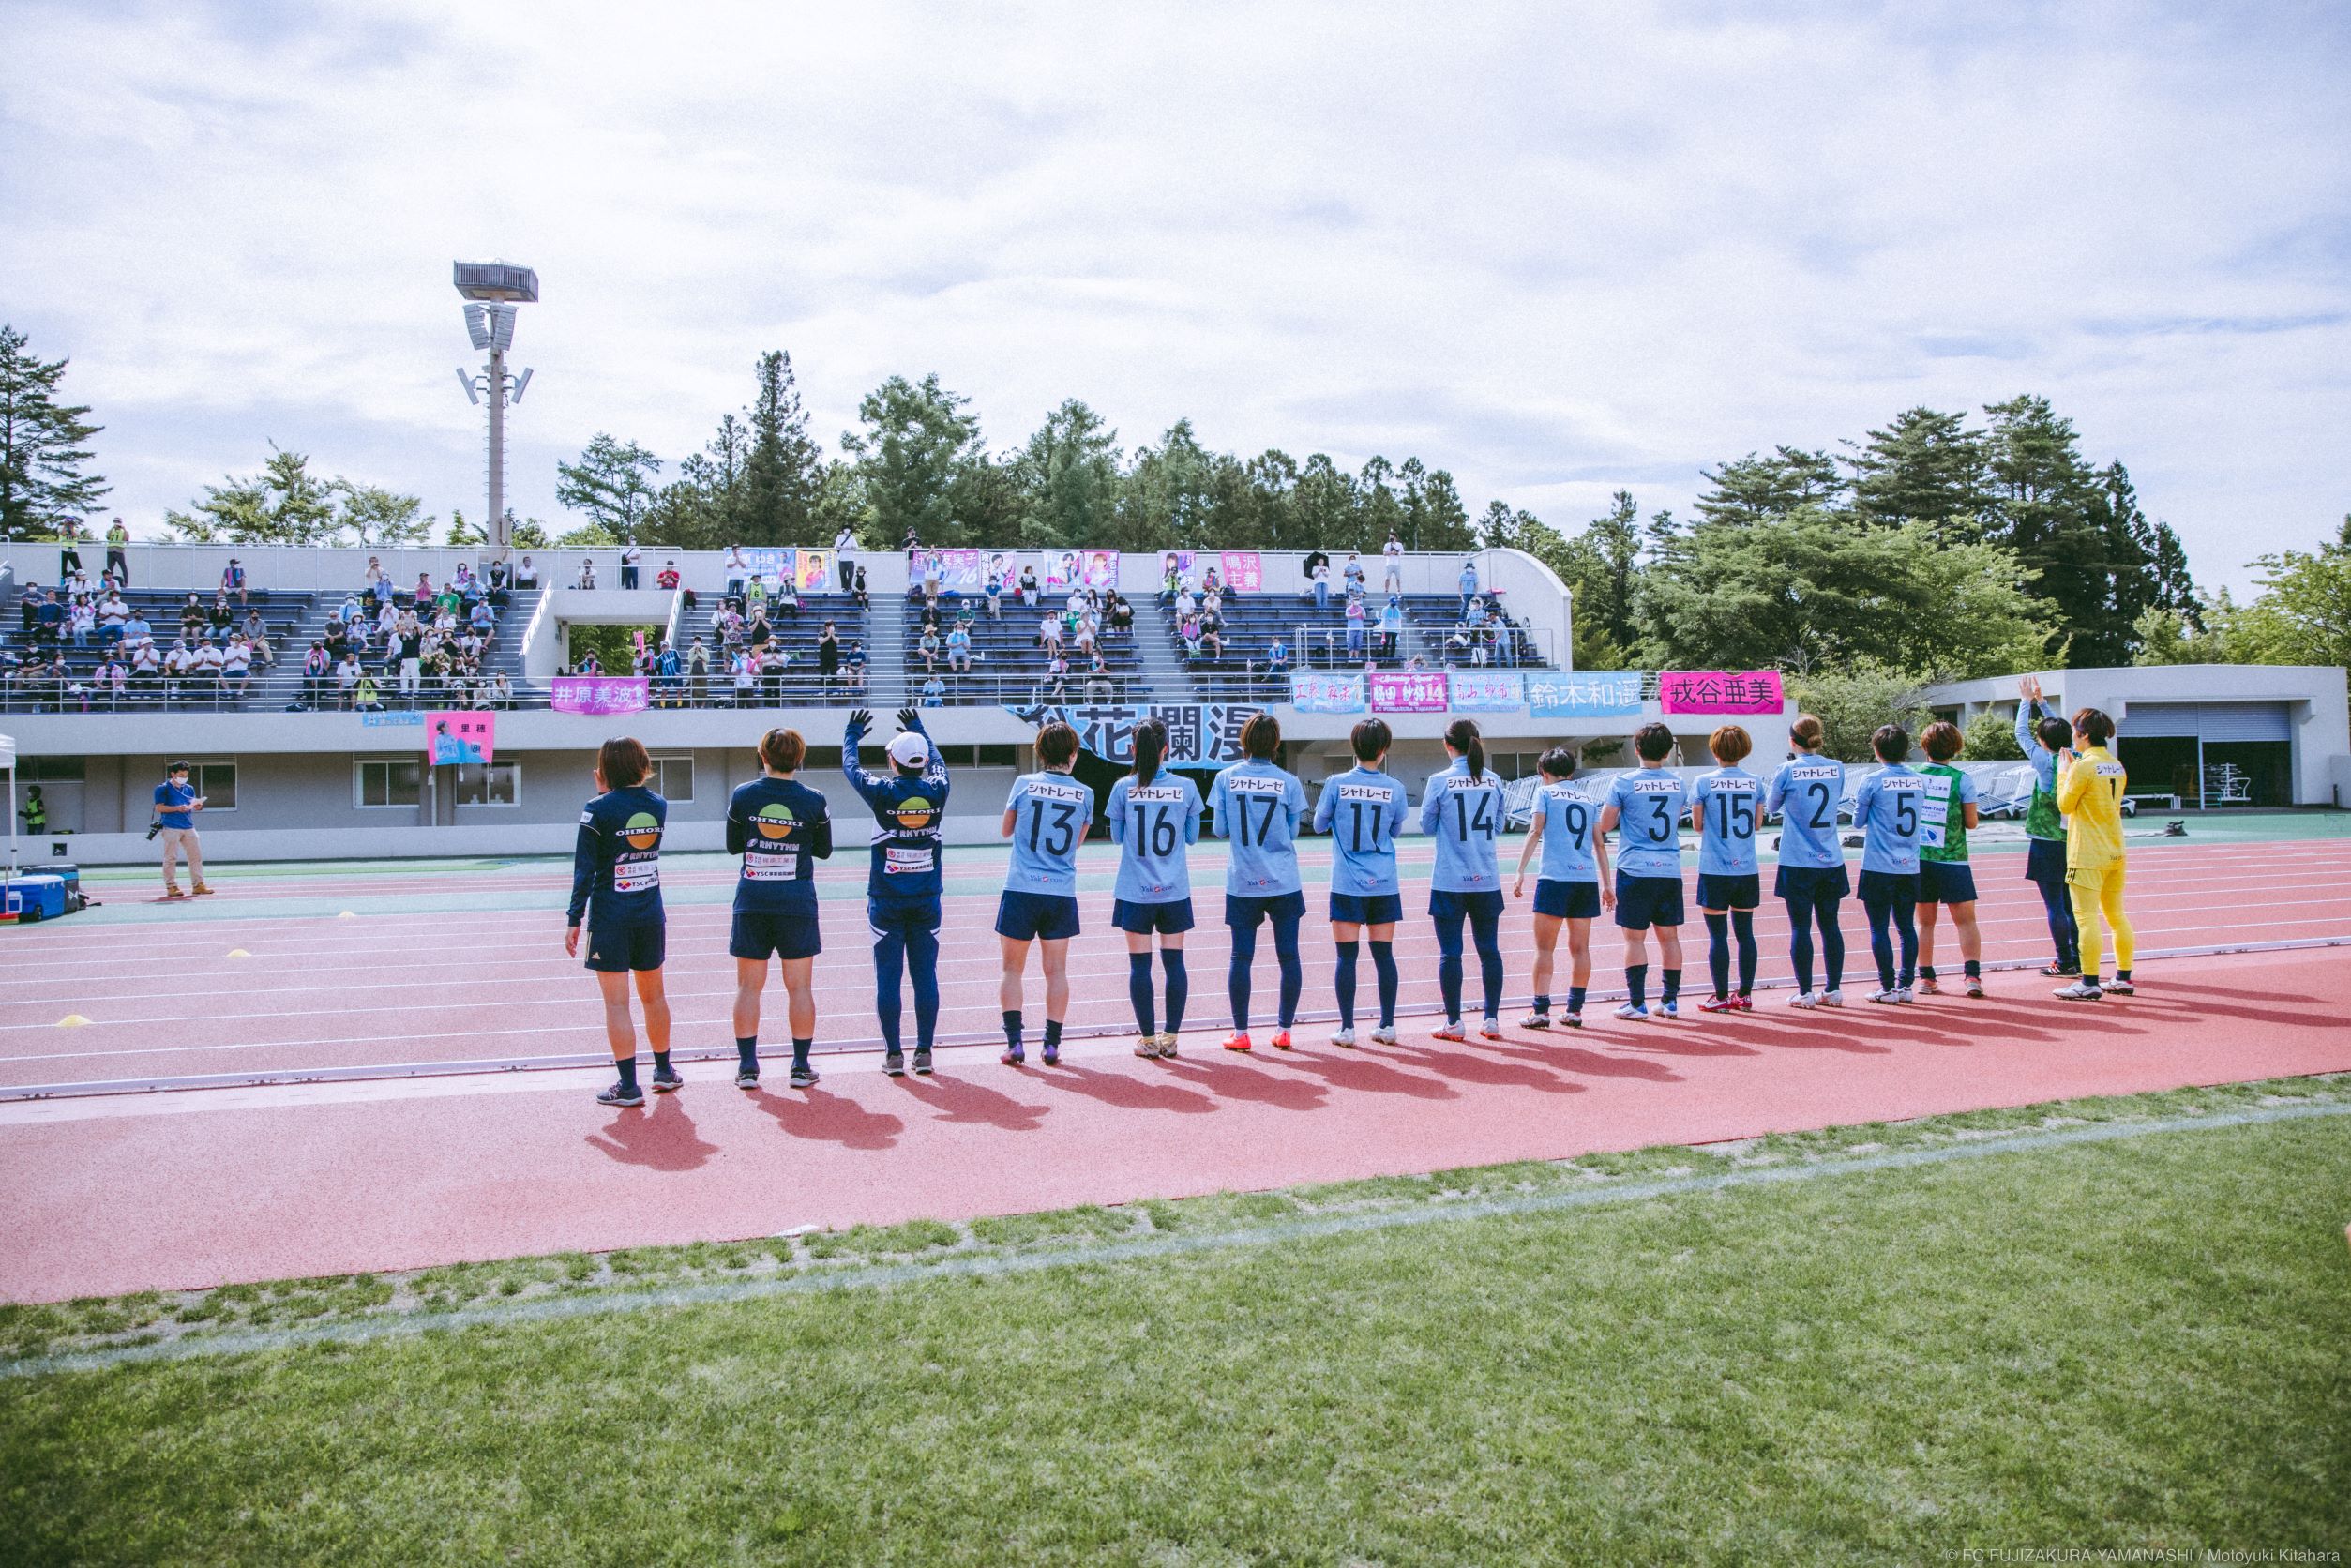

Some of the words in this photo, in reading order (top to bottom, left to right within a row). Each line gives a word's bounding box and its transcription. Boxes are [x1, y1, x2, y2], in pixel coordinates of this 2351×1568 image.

[1225, 554, 1258, 570] 鳴沢
[959, 566, 978, 585] 16
[1228, 571, 1258, 588] 主義
[754, 590, 760, 598] 6
[554, 685, 633, 704] 井原美波
[1425, 683, 1445, 701] 14
[1530, 680, 1641, 710] 鈴木和遥
[1670, 678, 1775, 706] 戎谷亜美
[1792, 767, 1838, 779] シャトレーゼ
[1028, 782, 1084, 800] シャトレーゼ
[1230, 778, 1284, 793] シャトレーゼ
[1448, 776, 1496, 789] シャトレーゼ
[1635, 780, 1680, 792] シャトレーゼ
[1711, 779, 1756, 790] シャトレーゼ
[2109, 777, 2116, 801] 1
[1127, 788, 1183, 801] シャトレーゼ
[1340, 786, 1392, 801] シャトレーゼ
[886, 807, 941, 816] OHMORI
[1807, 782, 1831, 829] 2
[748, 815, 804, 827] OHMORI
[1235, 794, 1278, 847] 17
[1454, 792, 1494, 842] 14
[1648, 795, 1671, 843] 3
[1716, 793, 1755, 840] 15
[1895, 792, 1916, 838] 5
[615, 827, 663, 837] OHMORI
[899, 825, 937, 837] RHYTHM
[1030, 800, 1078, 856] 13
[1133, 805, 1177, 857] 16
[1350, 802, 1382, 853] 11
[1565, 803, 1587, 850] 9
[759, 839, 800, 852] RHYTHM
